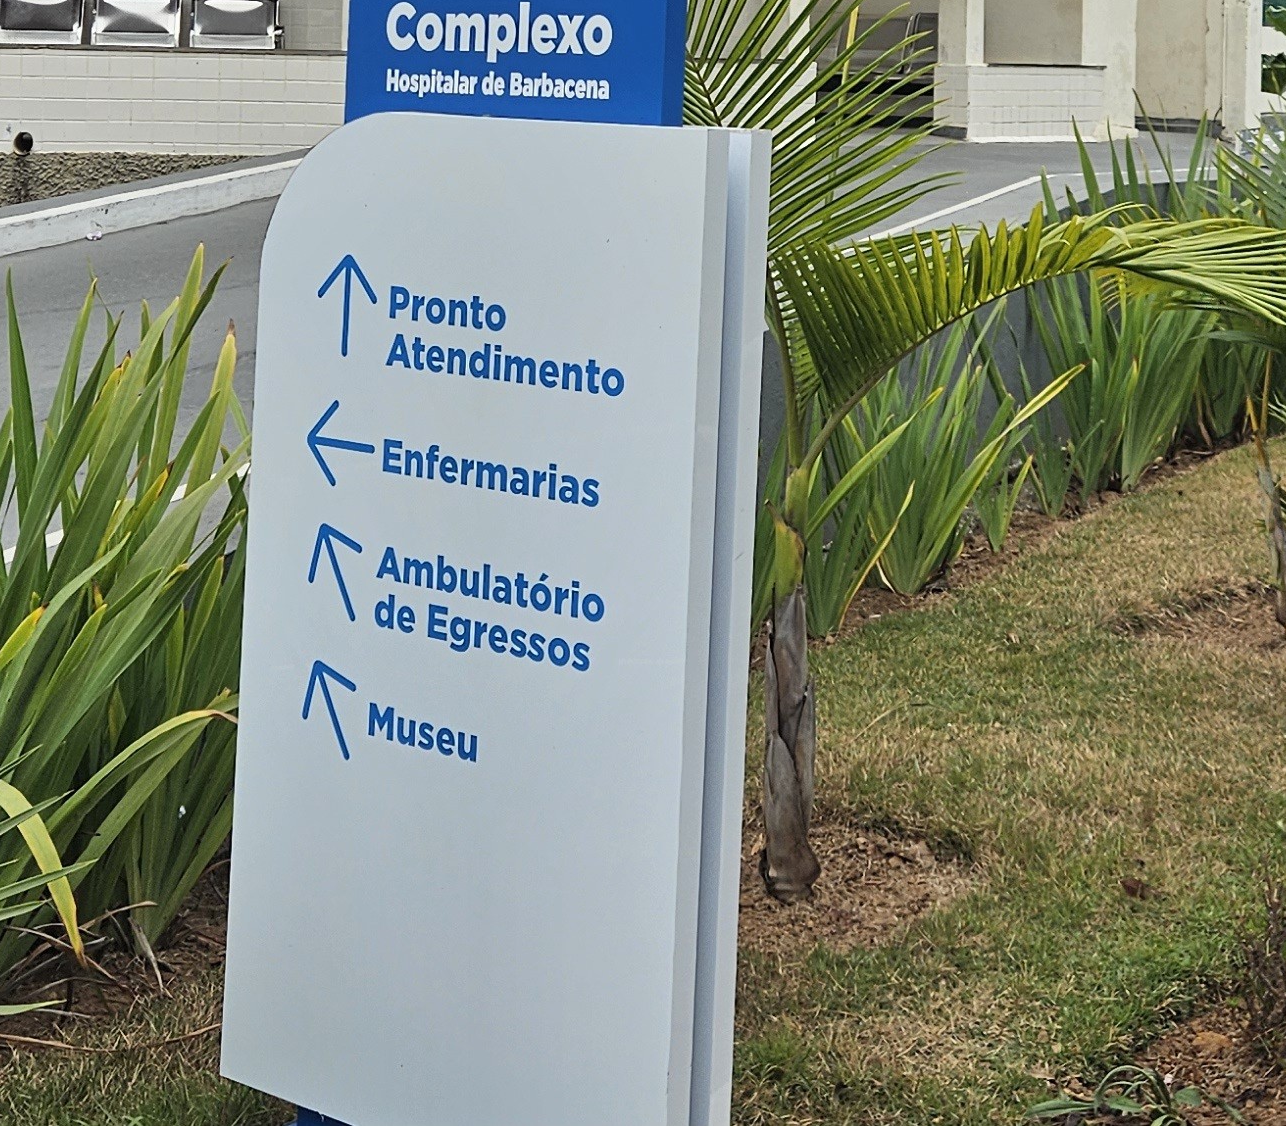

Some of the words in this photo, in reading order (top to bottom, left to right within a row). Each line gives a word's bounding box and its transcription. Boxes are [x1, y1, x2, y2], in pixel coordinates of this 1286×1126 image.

[386, 1, 613, 63] Complexo
[385, 68, 479, 98] Hospitalar
[481, 70, 505, 96] de
[509, 71, 611, 100] Barbacena
[388, 285, 507, 332] Pronto
[385, 333, 626, 397] Atendimento
[382, 438, 600, 508] Enfermarias
[376, 546, 605, 623] Ambulatório
[374, 593, 416, 634] de
[426, 604, 591, 673] Egressos
[367, 701, 478, 764] Museu
